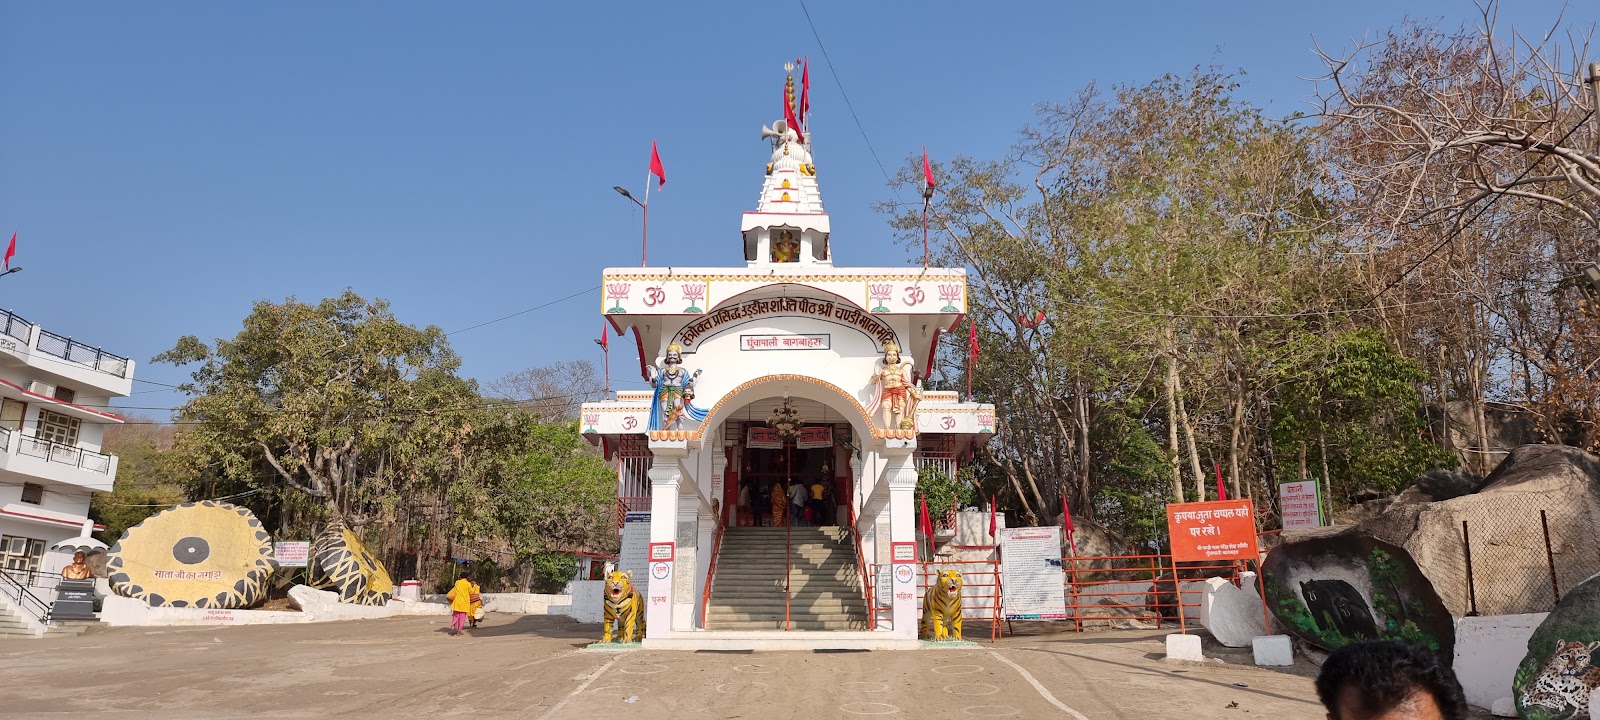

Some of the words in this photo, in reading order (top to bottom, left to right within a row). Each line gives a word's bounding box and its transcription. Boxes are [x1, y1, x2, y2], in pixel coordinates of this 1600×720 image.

[712, 307, 742, 327] प्रसिद्ध
[770, 298, 797, 313] शक्ति
[798, 298, 817, 314] पीठ
[817, 303, 834, 317] श्री
[835, 306, 861, 325] चण्डी
[859, 315, 881, 336] माता
[877, 328, 898, 347] मंदि
[746, 337, 778, 349] घुंचापाली
[782, 337, 822, 348] बागबाहरा
[1174, 511, 1197, 524] कृपया
[1213, 508, 1235, 519] चप्पल
[1235, 504, 1250, 518] यहाँ
[1189, 527, 1201, 537] पर
[155, 570, 174, 579] माता
[174, 569, 185, 579] जी
[185, 571, 197, 579] का
[896, 592, 913, 601] महिला
